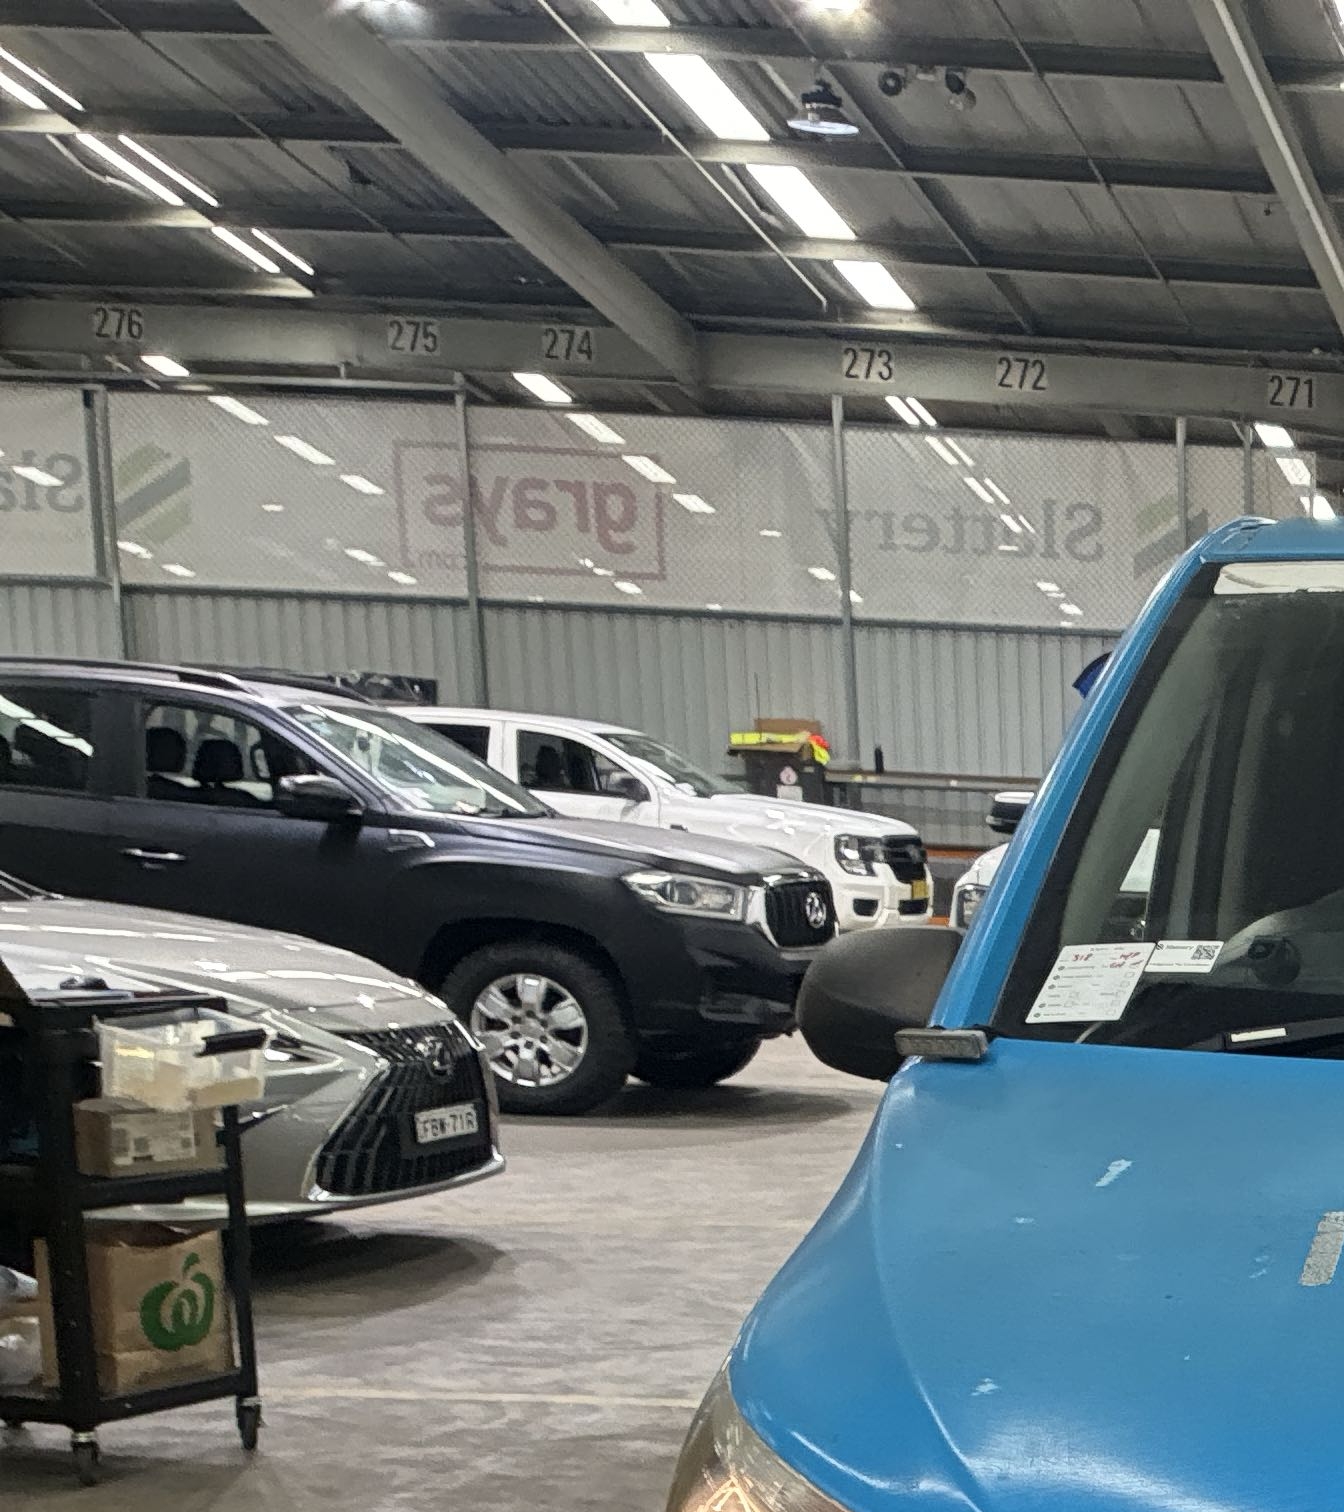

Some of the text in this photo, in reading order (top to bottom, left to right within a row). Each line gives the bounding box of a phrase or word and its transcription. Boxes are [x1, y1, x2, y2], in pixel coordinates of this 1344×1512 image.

[95, 308, 143, 339] 276
[389, 321, 438, 353] 275
[544, 328, 593, 361] 274
[844, 347, 893, 380] 273
[998, 357, 1046, 390] 272
[1269, 375, 1316, 407] 271
